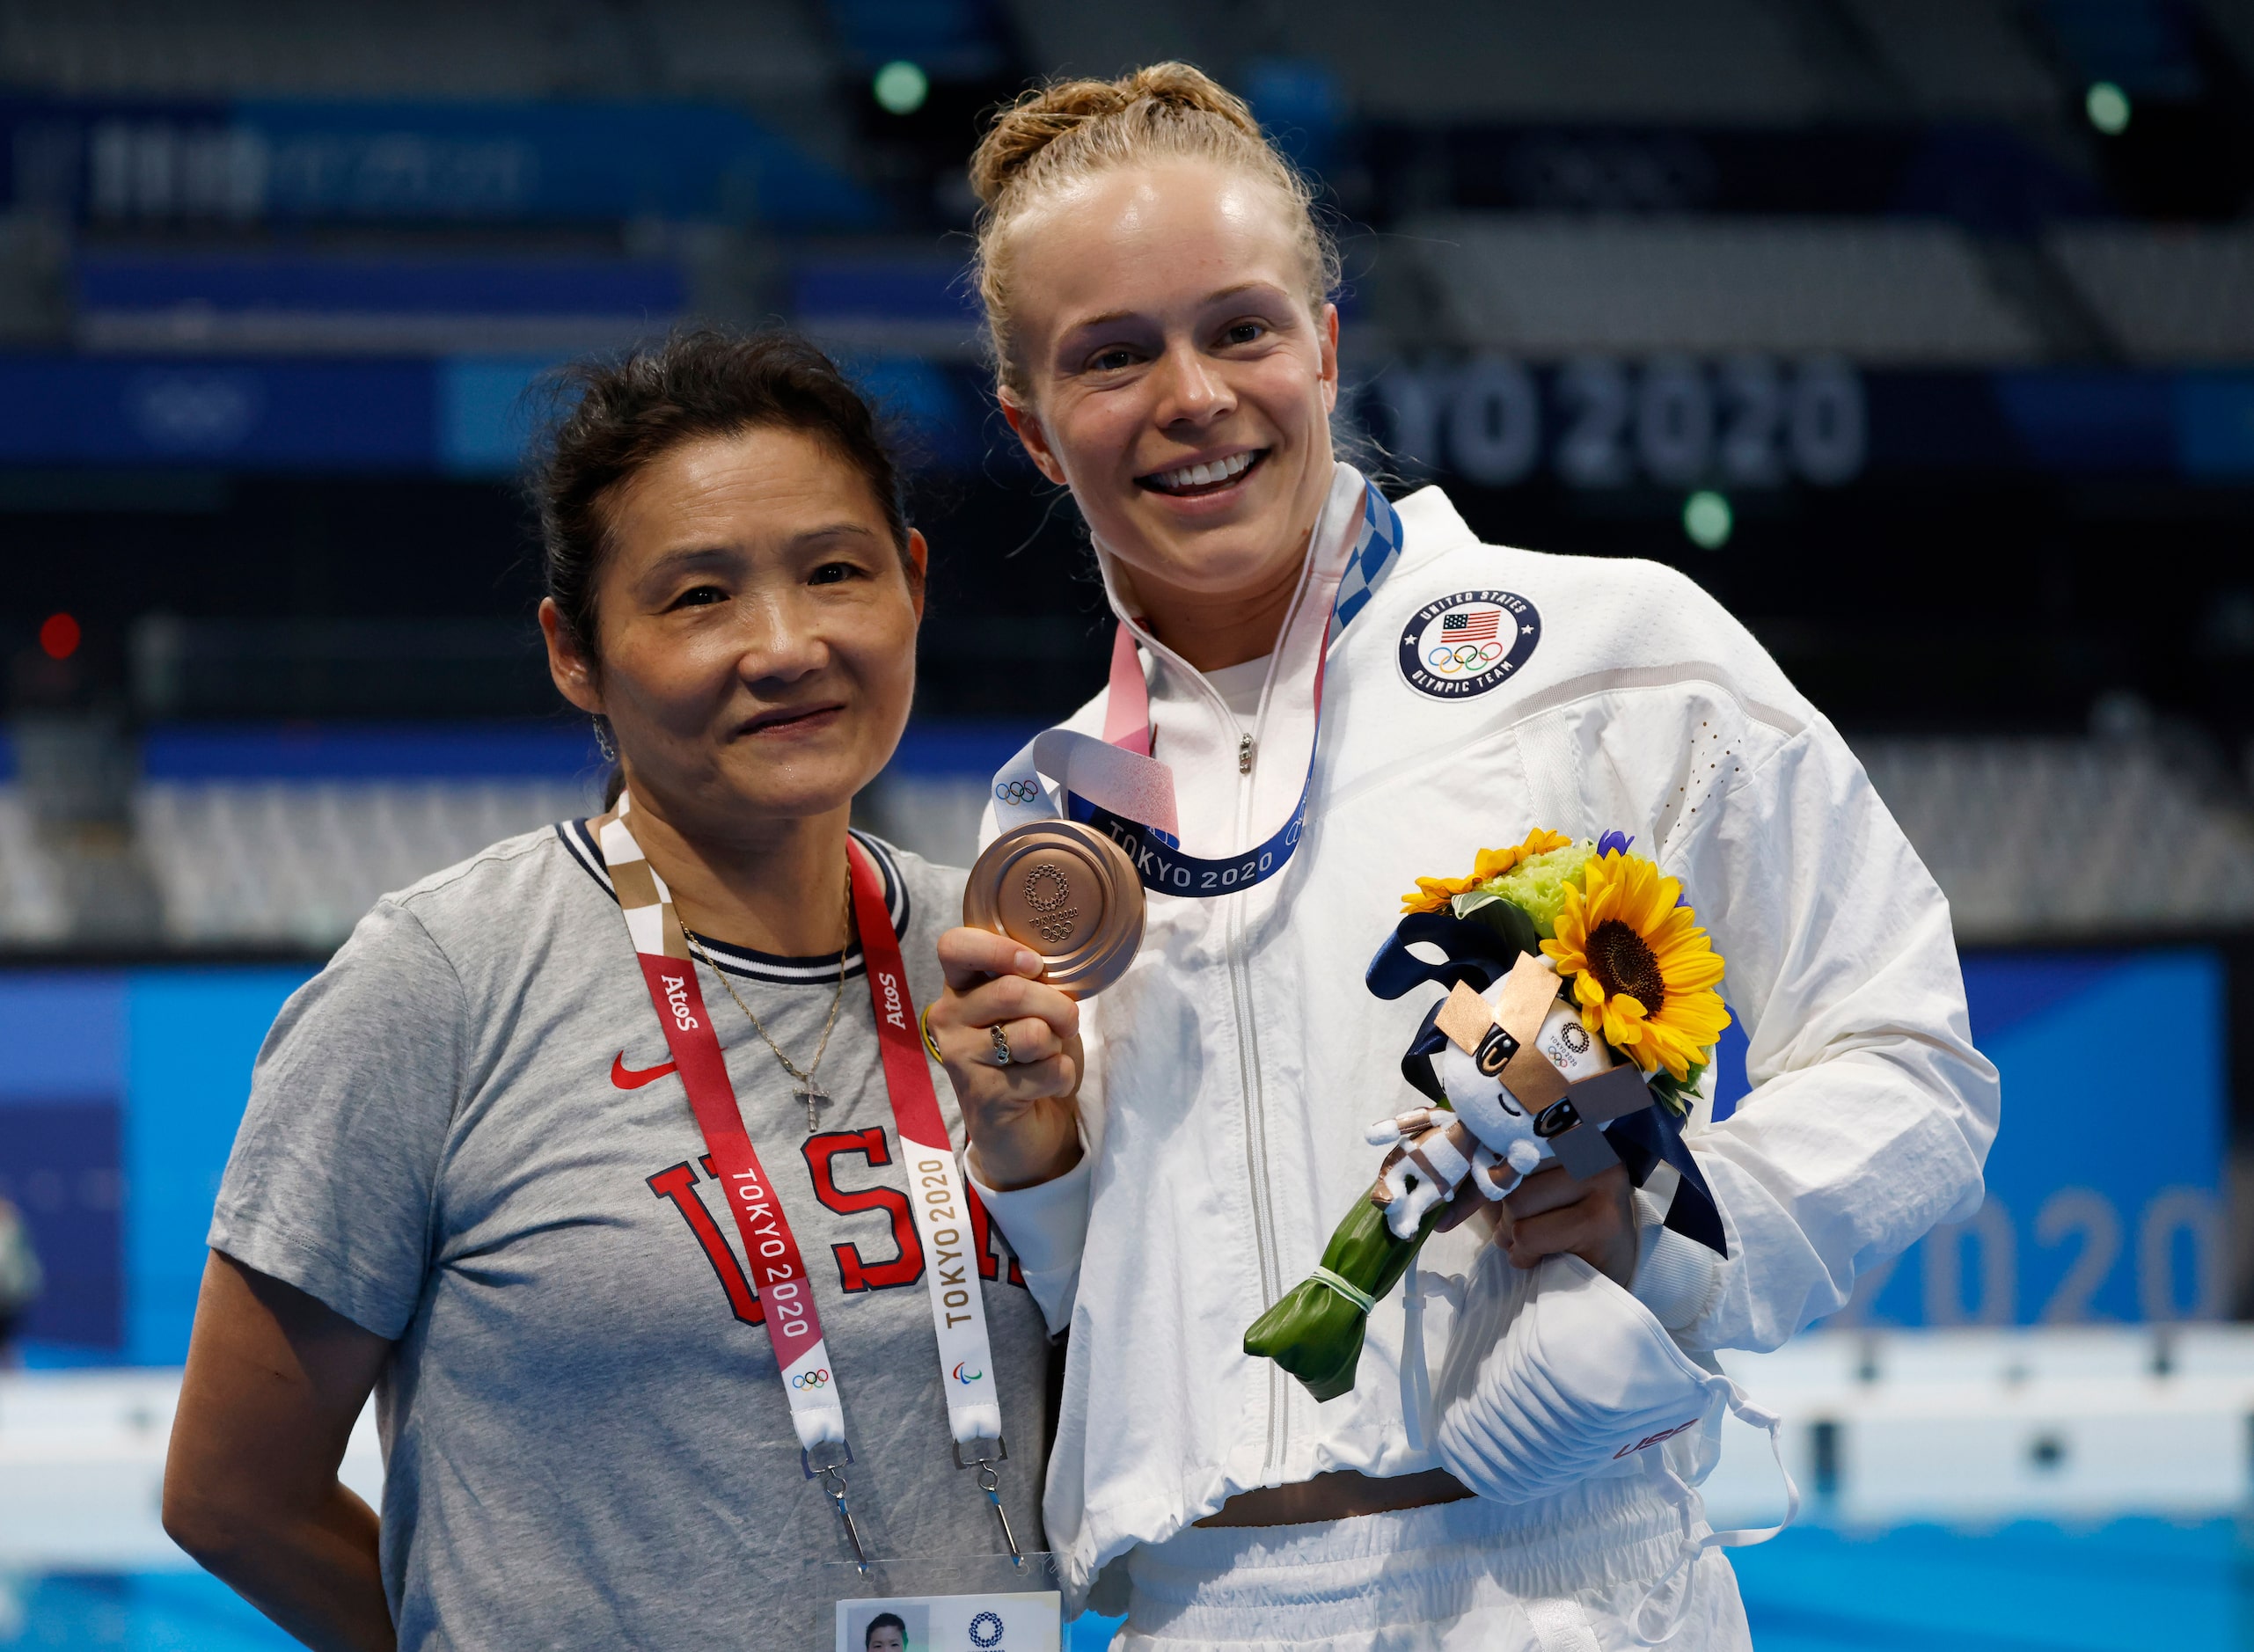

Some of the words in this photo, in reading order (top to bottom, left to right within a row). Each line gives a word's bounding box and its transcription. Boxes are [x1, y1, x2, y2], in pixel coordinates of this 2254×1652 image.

[1555, 355, 1865, 486] 2020
[1420, 591, 1474, 621] UNITED
[1480, 589, 1528, 615] STATES
[1411, 669, 1470, 693] OLYMPIC
[1477, 660, 1514, 688] TEAM
[1109, 820, 1191, 888] TOKYO
[1200, 852, 1273, 888] 2020
[1028, 913, 1057, 929] TOKYO
[1058, 907, 1079, 920] 2020
[1550, 1035, 1567, 1054] TOKYO
[1565, 1052, 1577, 1067] 2020
[918, 1159, 955, 1223] 2020
[732, 1166, 786, 1261] TOKYO
[767, 1263, 809, 1338] 2020
[933, 1230, 972, 1329] TOKYO
